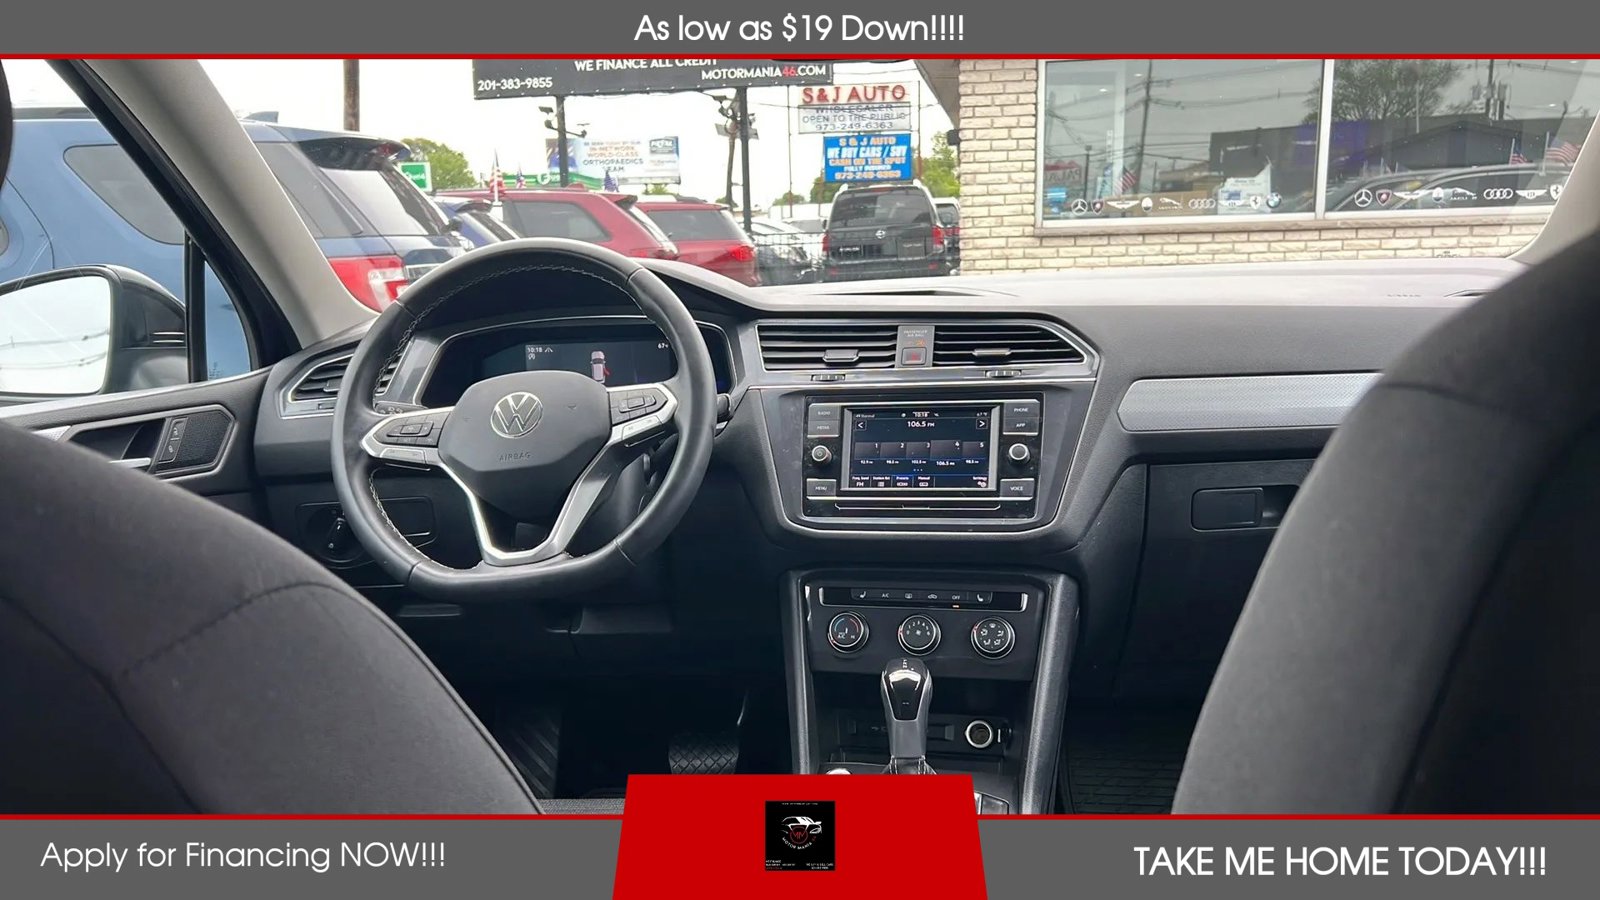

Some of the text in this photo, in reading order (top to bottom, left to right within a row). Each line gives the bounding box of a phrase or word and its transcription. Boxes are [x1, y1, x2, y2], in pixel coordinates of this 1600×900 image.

[574, 60, 594, 71] WE
[596, 59, 648, 71] FINANCE
[650, 59, 673, 69] ALL
[701, 65, 826, 80] MOTORMANIA46.COM
[477, 76, 553, 91] 201-383-9855
[847, 84, 906, 102] AUTO
[802, 112, 906, 124] OPEN TO THE PUBLIC
[815, 121, 894, 131] 973-249-6363
[500, 451, 531, 462] AIRBAG
